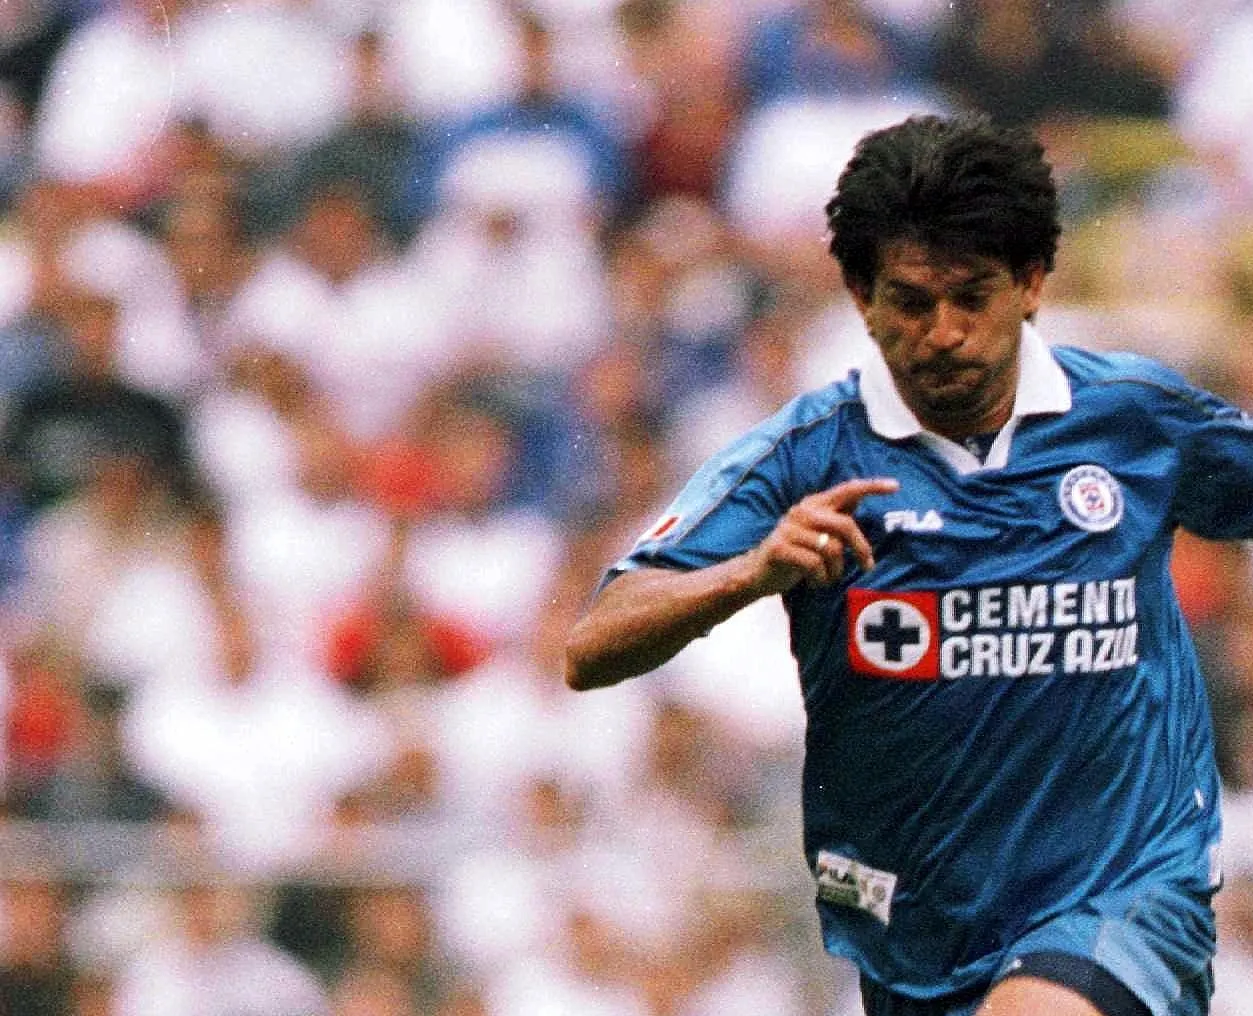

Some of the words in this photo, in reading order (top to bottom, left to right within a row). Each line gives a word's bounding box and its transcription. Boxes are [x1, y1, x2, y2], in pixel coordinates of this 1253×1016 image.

[883, 509, 944, 533] FILA
[941, 632, 1055, 679] CRUZ
[1063, 622, 1138, 674] AZUL
